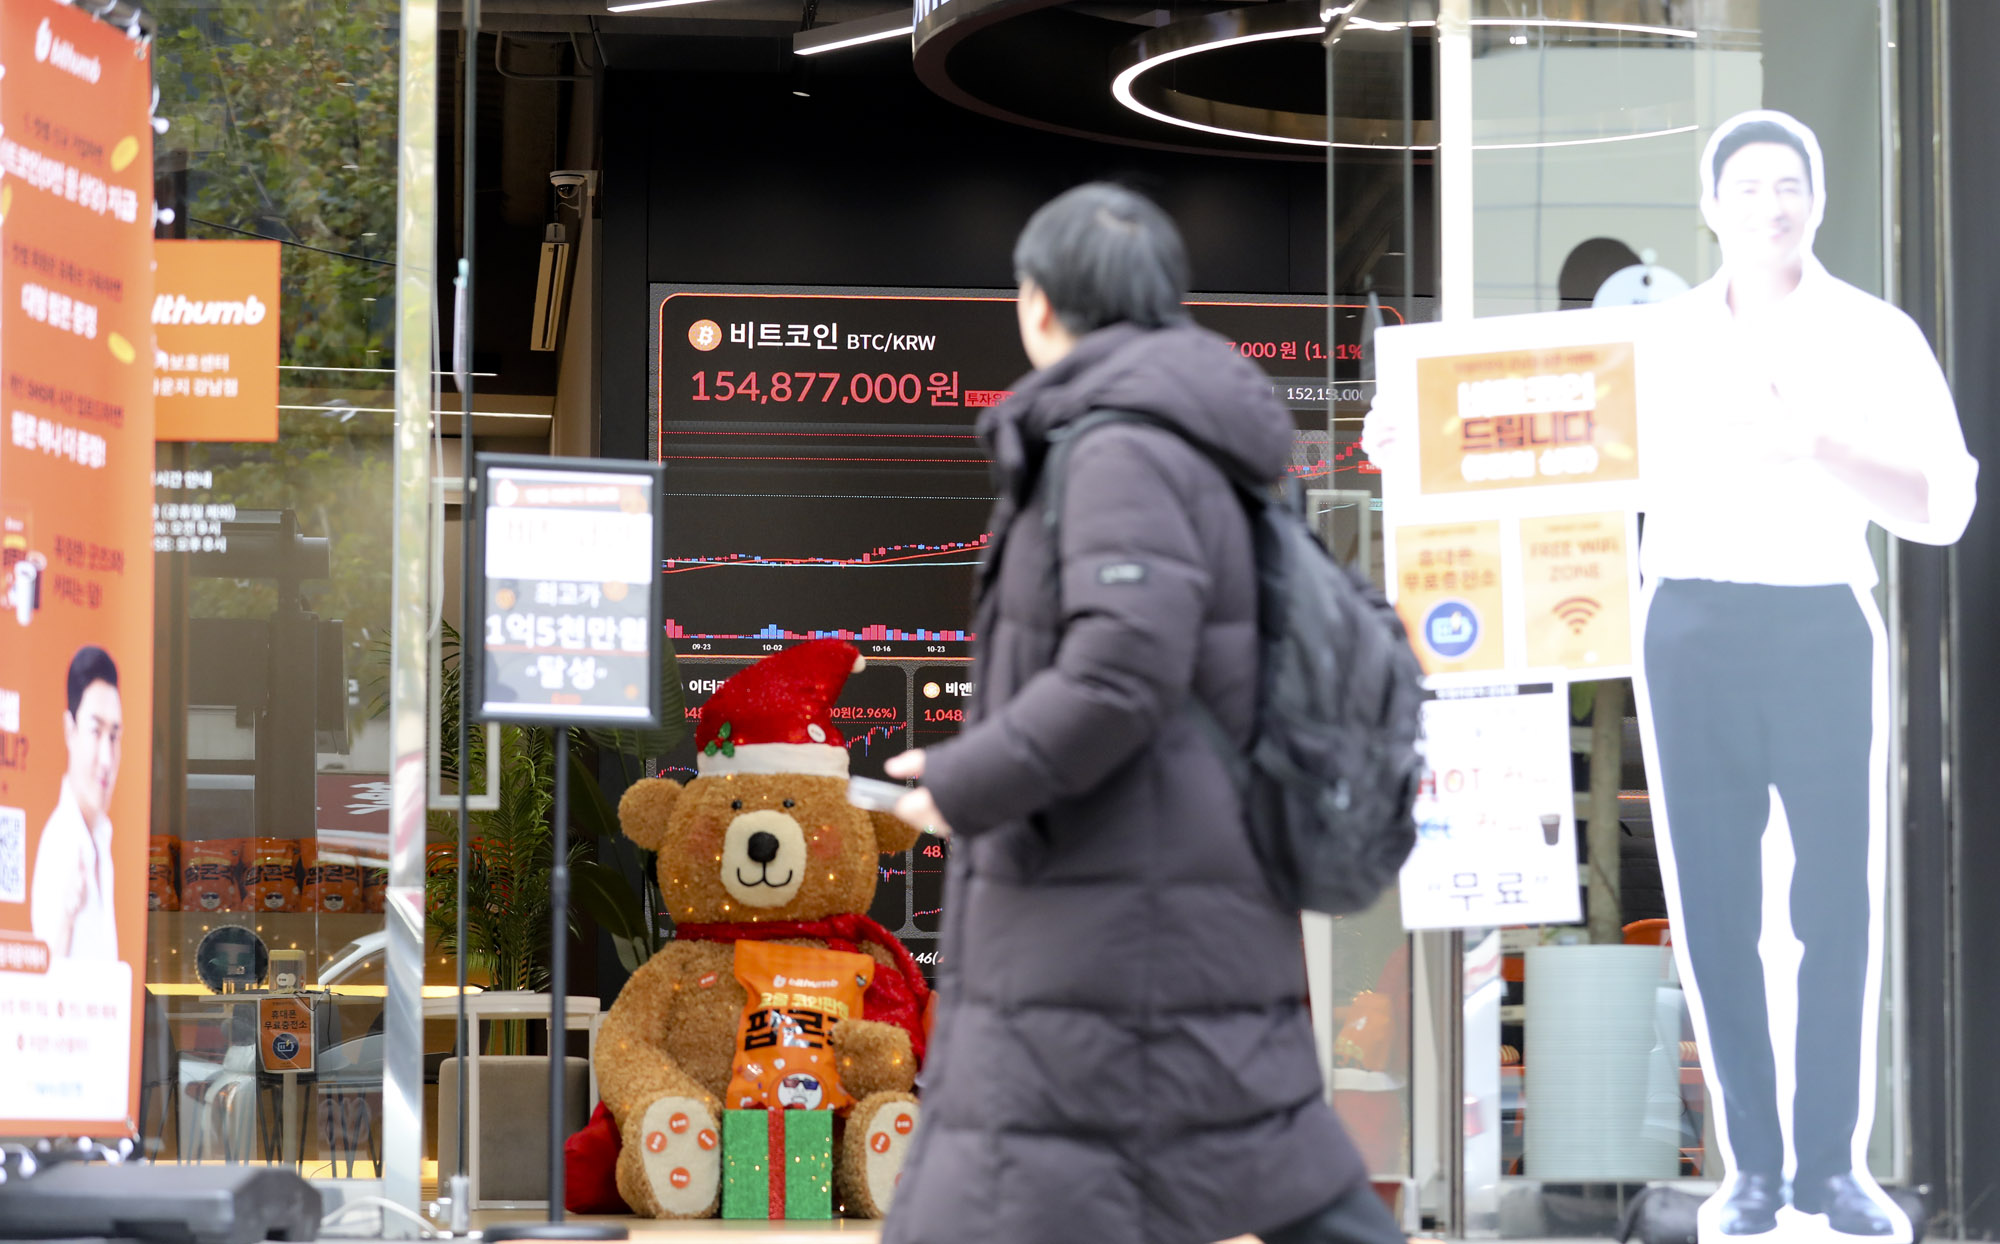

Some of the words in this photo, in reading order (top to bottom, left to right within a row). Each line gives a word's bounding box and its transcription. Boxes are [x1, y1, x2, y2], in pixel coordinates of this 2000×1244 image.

[731, 321, 838, 349] 비트코인
[847, 333, 936, 352] BTC/KRW
[154, 353, 229, 372] 보호센터
[1460, 410, 1595, 450] 드립니다
[152, 470, 182, 488] 시간
[1530, 540, 1572, 558] FREE
[1550, 562, 1600, 582] ZONE
[536, 582, 602, 608] 최고가
[271, 1009, 297, 1020] 휴대폰
[264, 1020, 308, 1031] 무료충전소
